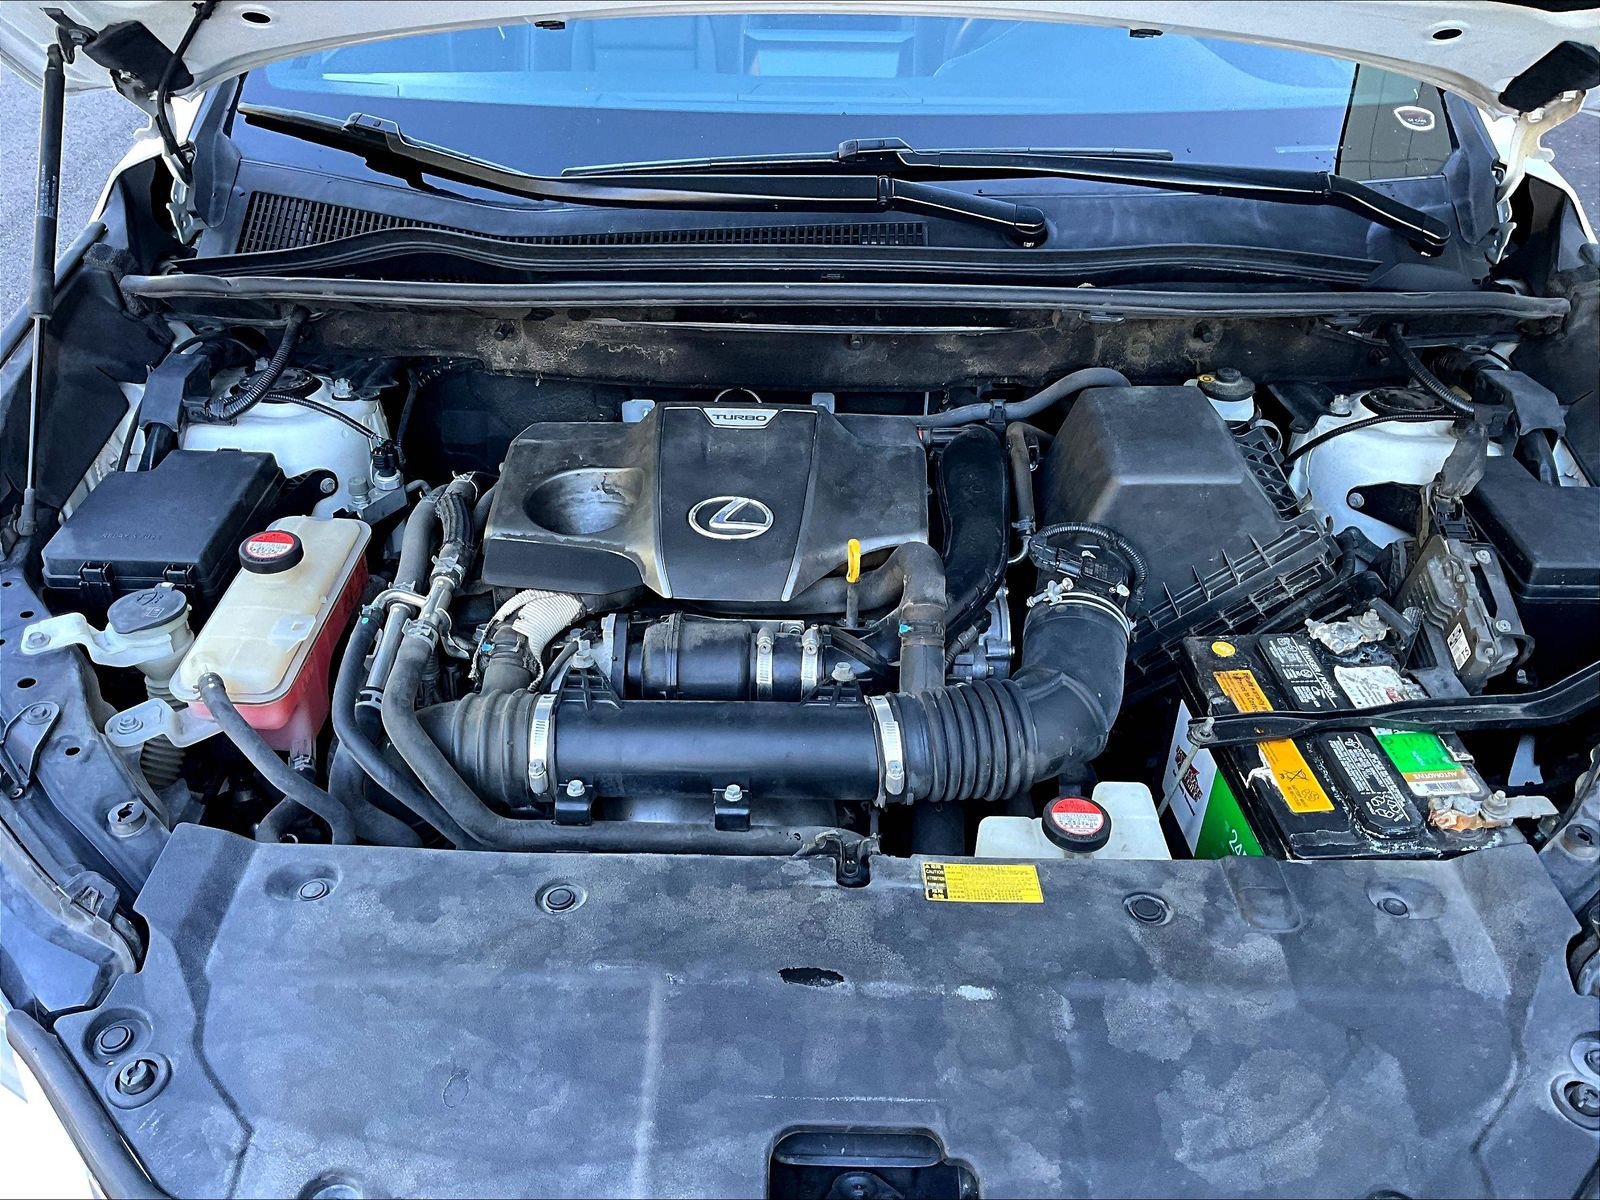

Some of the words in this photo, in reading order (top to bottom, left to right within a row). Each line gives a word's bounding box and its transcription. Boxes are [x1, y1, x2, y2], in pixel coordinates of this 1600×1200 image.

[711, 413, 768, 422] TURBO
[1301, 650, 1321, 673] DANGER
[1318, 676, 1338, 698] POISON
[1413, 771, 1457, 780] AUTOMOTIVE
[1228, 828, 1248, 856] 24
